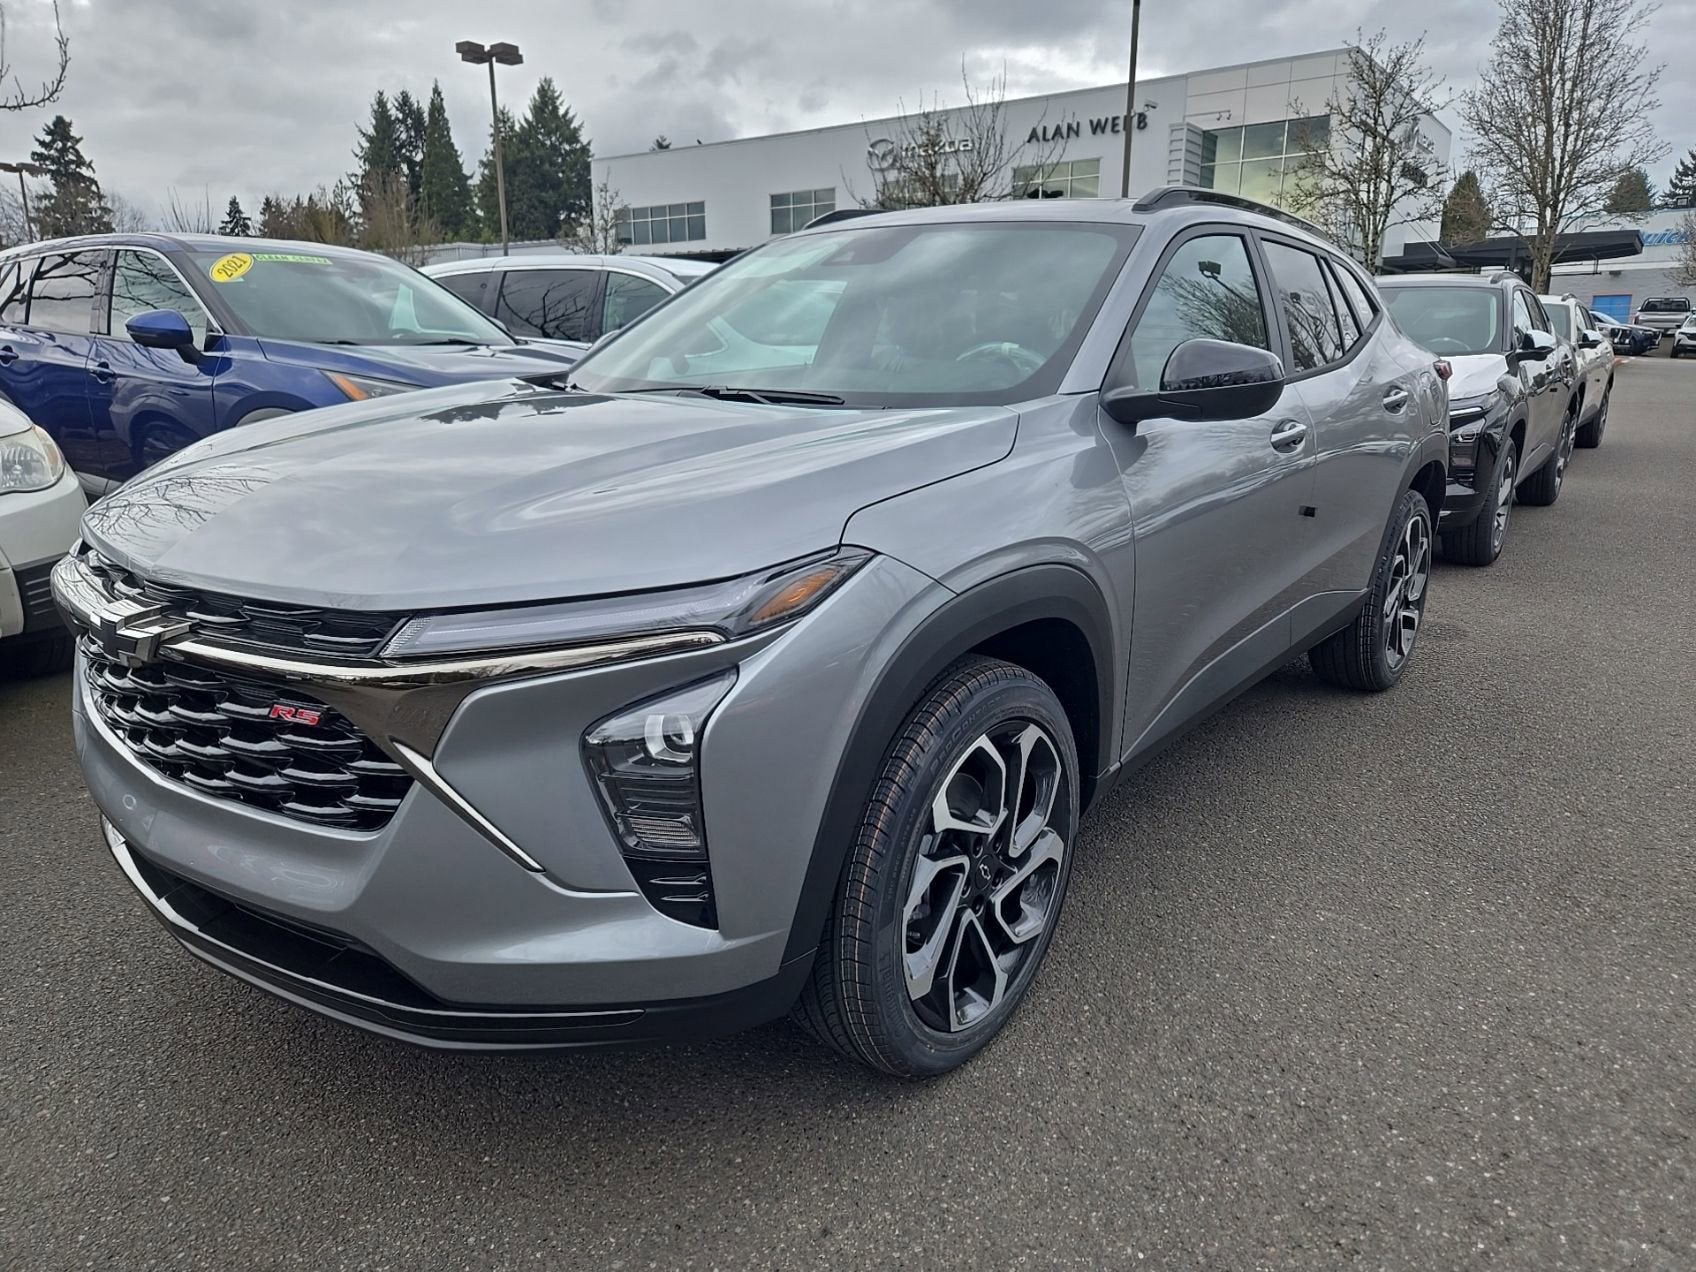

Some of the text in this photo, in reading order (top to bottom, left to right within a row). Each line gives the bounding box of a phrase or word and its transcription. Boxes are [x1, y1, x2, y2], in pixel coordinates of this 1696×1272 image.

[1027, 121, 1080, 143] ALAN
[217, 256, 247, 278] 2021
[269, 704, 321, 726] RS
